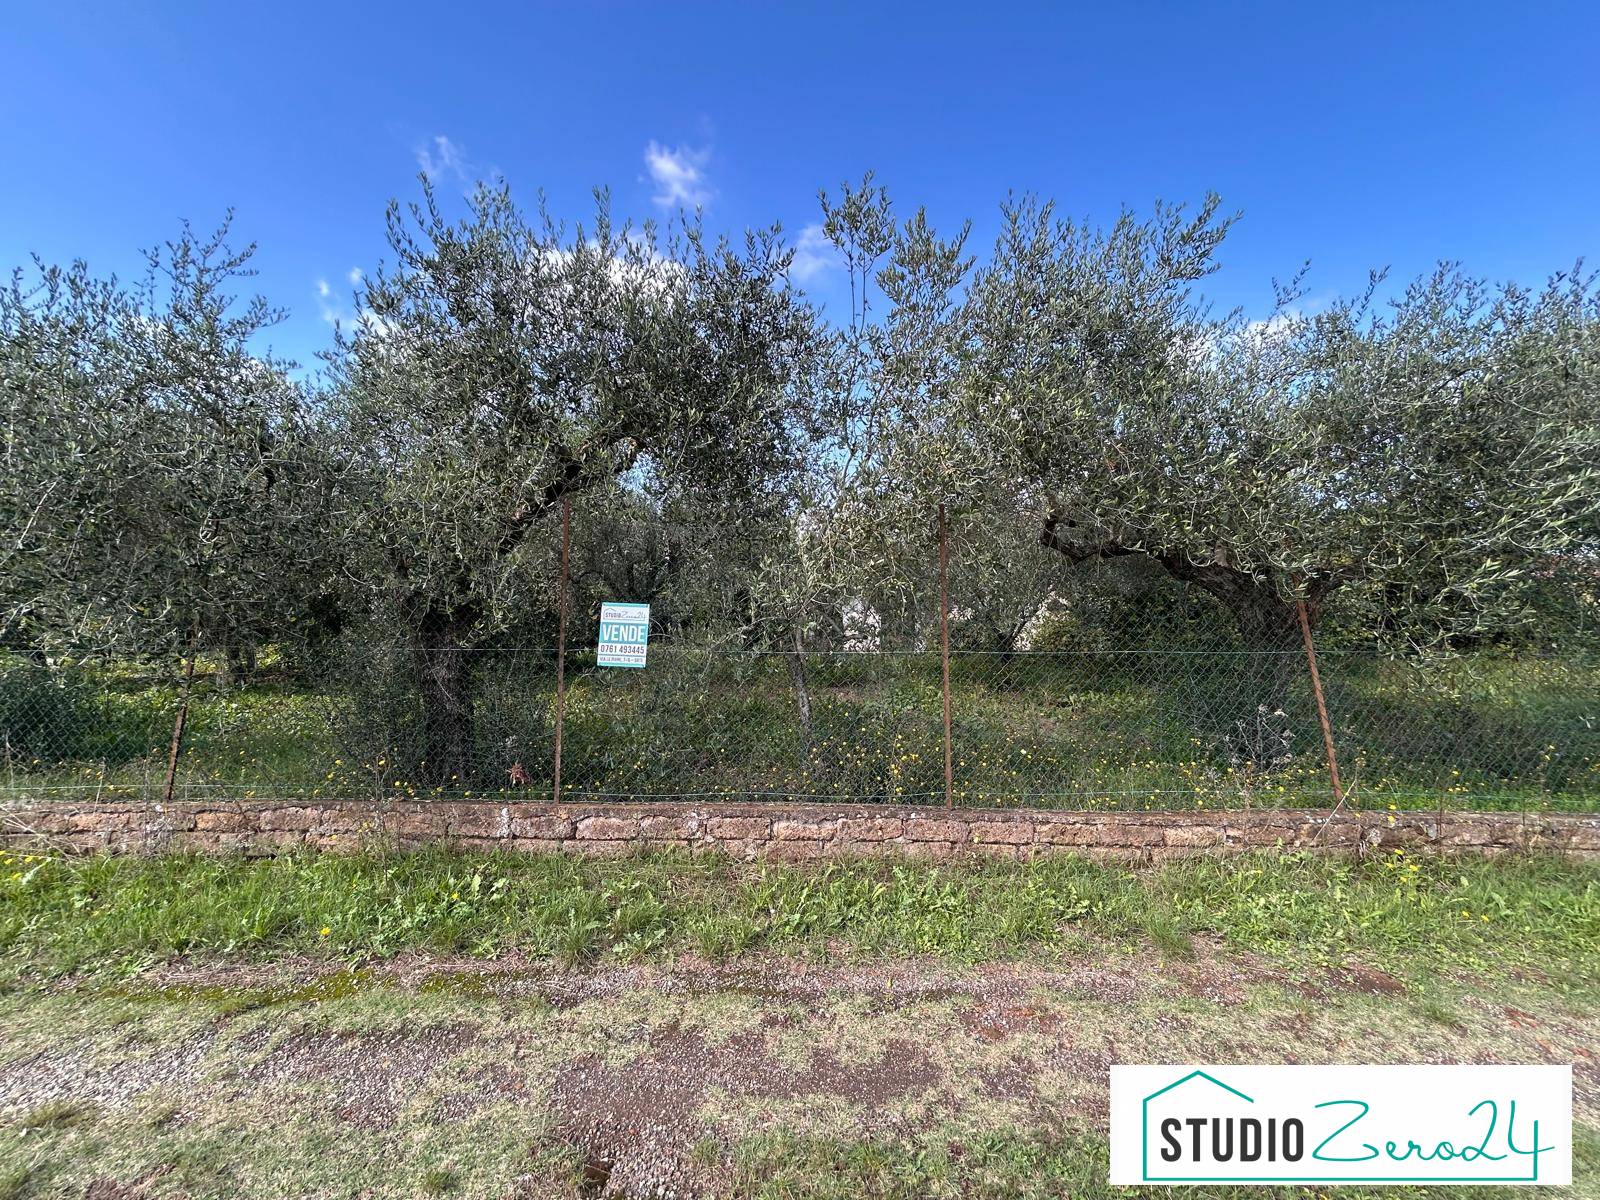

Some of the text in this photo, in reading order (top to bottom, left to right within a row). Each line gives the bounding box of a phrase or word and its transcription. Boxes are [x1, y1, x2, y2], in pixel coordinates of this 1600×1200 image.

[602, 624, 646, 643] VENDE
[600, 644, 645, 655] 0761 493445
